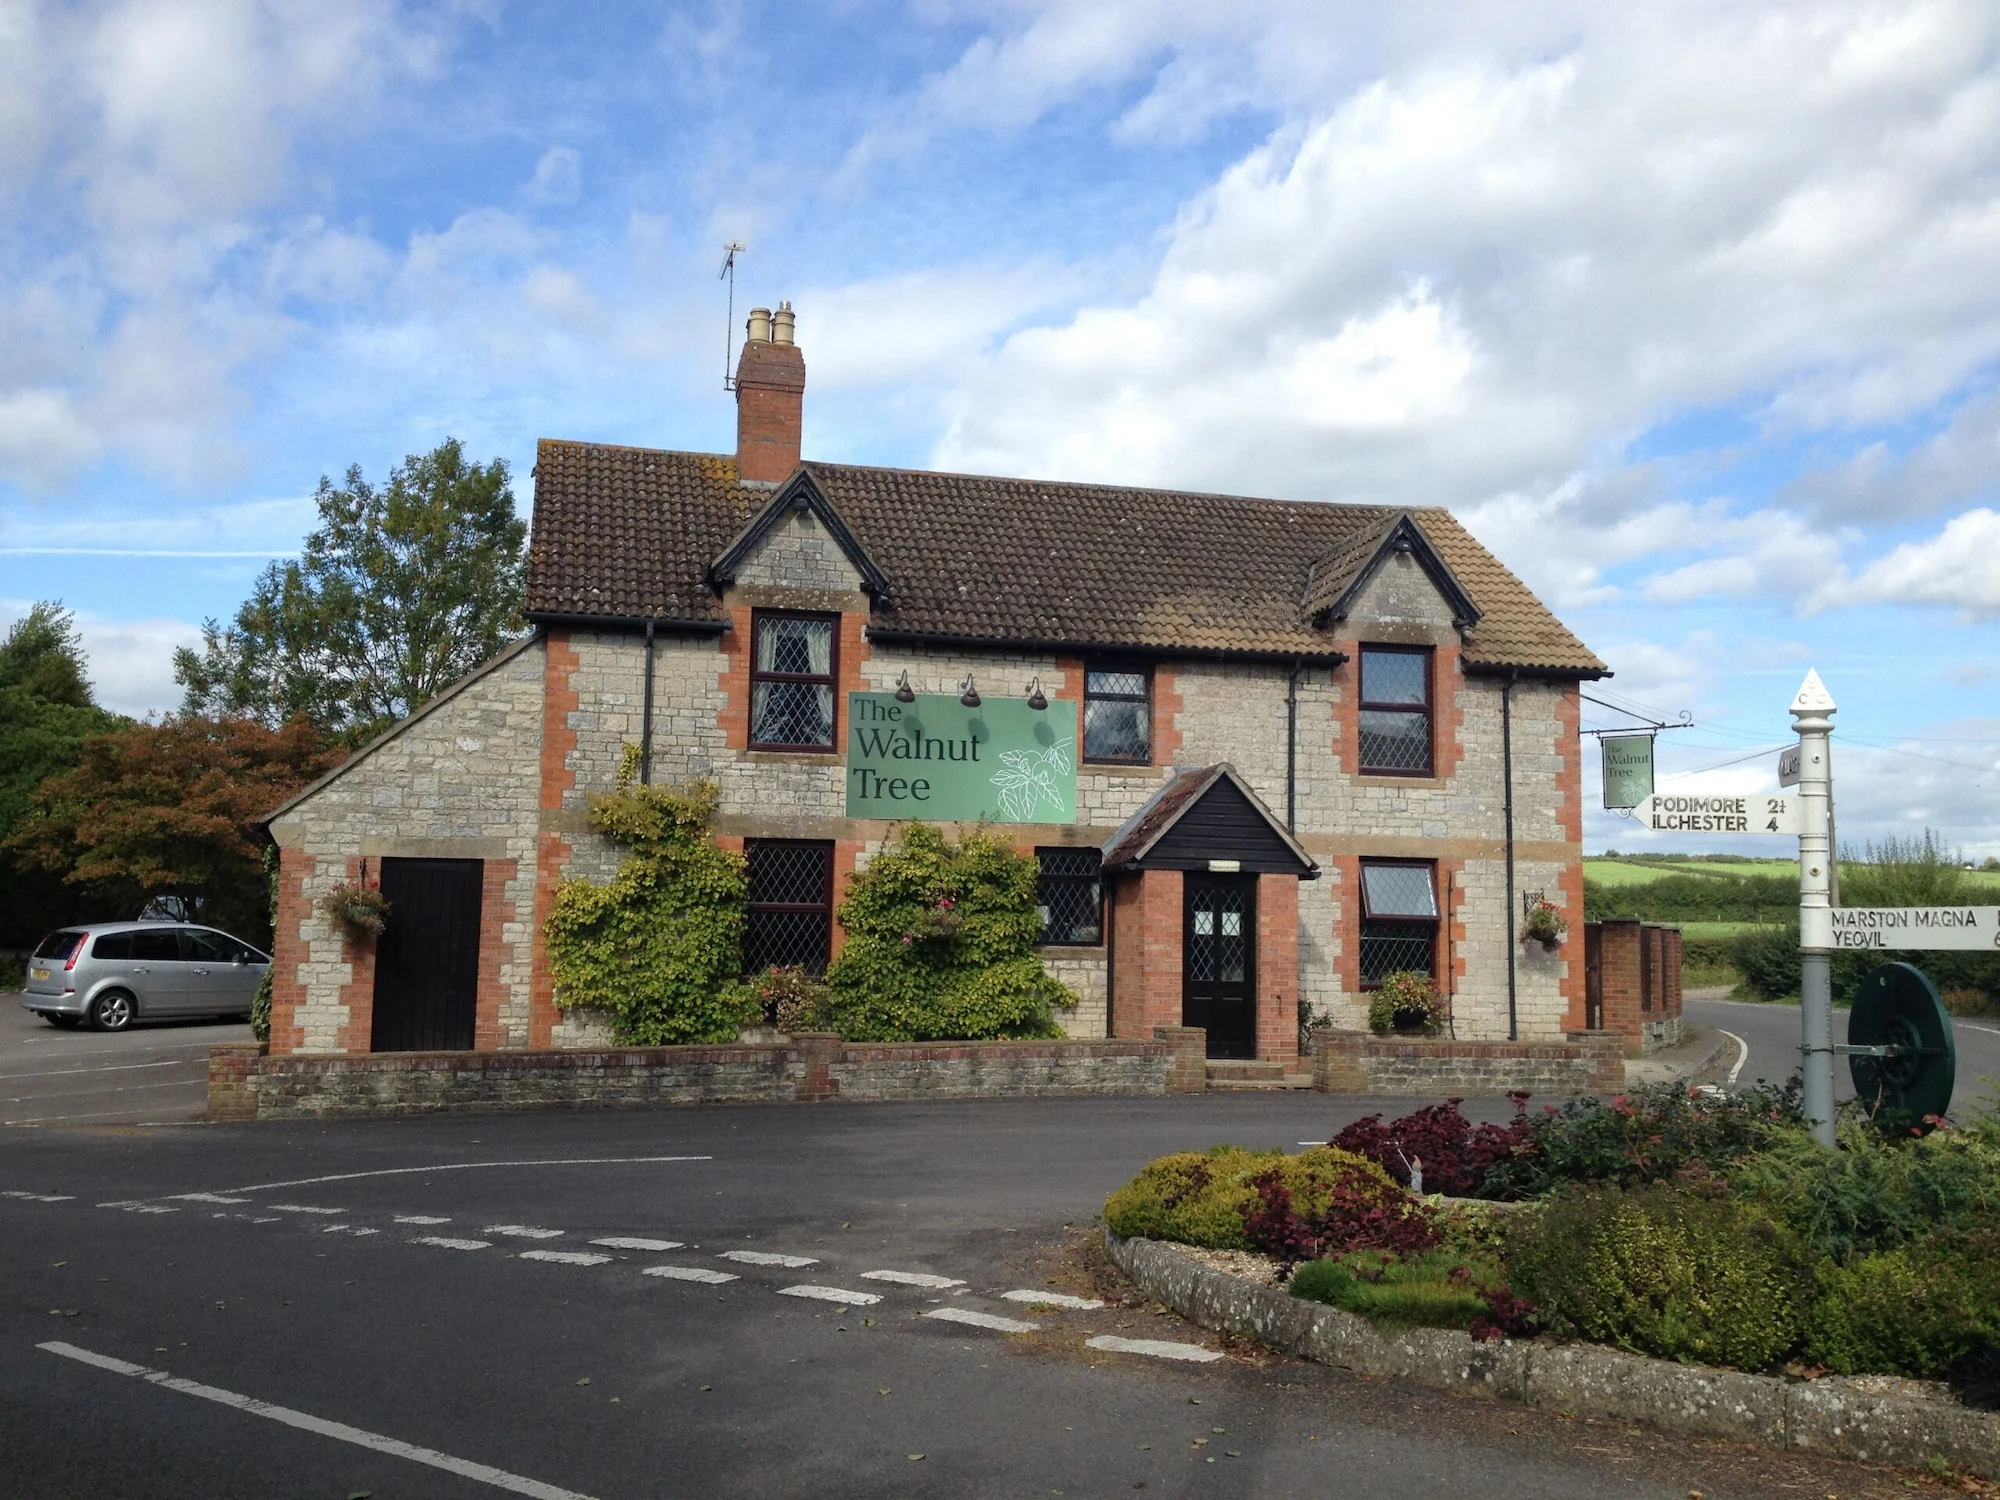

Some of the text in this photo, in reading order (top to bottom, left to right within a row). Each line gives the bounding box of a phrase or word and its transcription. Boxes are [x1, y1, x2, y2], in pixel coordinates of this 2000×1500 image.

[854, 698, 902, 722] The
[854, 727, 981, 762] Walnut
[1607, 753, 1650, 765] Walnut
[1606, 767, 1633, 778] Tree
[853, 767, 930, 801] Tree
[1652, 796, 1746, 814] PODIMORE
[1652, 813, 1779, 832] ILCHESTER 4
[1831, 910, 1908, 928] MARSTON
[1915, 909, 1977, 928] MAGNA
[1832, 929, 1887, 948] YEOVIL
